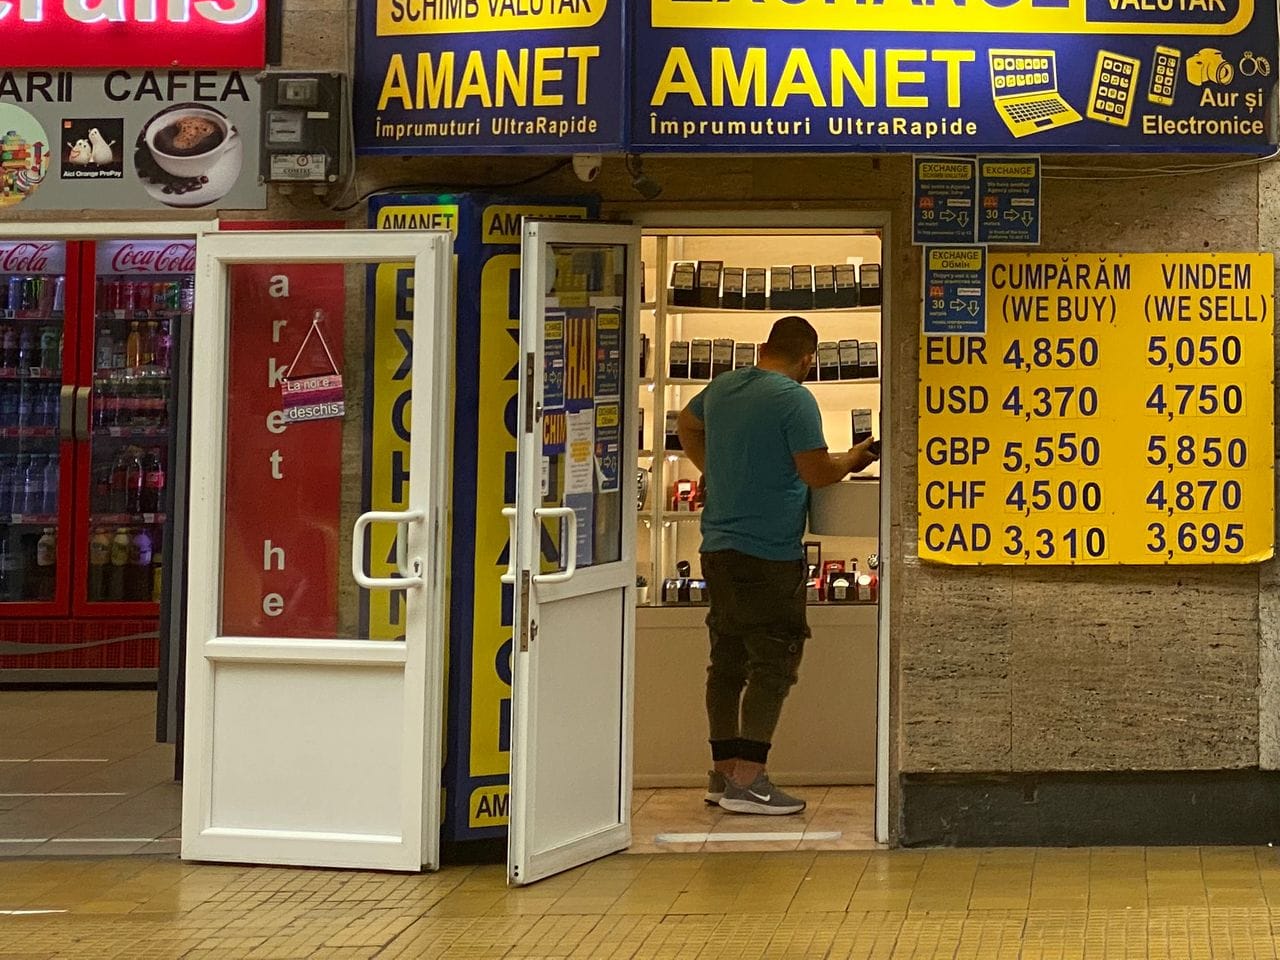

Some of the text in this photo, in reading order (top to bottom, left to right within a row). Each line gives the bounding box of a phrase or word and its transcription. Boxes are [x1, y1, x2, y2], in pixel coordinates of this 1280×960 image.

[104, 71, 250, 101] CAFEA
[377, 46, 600, 111] AMANET
[650, 47, 975, 108] AMANET
[1200, 87, 1263, 113] Aur și
[376, 116, 597, 140] Împrumuturi UltraRapide
[650, 113, 977, 140] Împrumuturi UltraRapide
[1143, 115, 1264, 136] Electronice
[923, 164, 968, 173] EXCHANGE
[987, 167, 1032, 175] EXCHANGE
[922, 210, 934, 219] 30
[986, 210, 998, 218] 30
[933, 251, 978, 260] EXCHANGE
[991, 258, 1131, 290] CUMPĂRĂM
[1161, 263, 1251, 290] VINDEM
[932, 300, 944, 308] 30
[1002, 295, 1267, 323] (WE BUY) (WE SELL)
[926, 335, 1242, 372] EUR 4,850 5,050
[288, 381, 300, 390] La
[290, 404, 338, 418] deschis
[926, 384, 1243, 421] USD 4,370 4,750
[926, 433, 1247, 471] GBP 5,550 5,850
[926, 480, 1242, 516] CHF 4,500 4,870
[926, 522, 1244, 560] CAD 3,310 3,695
